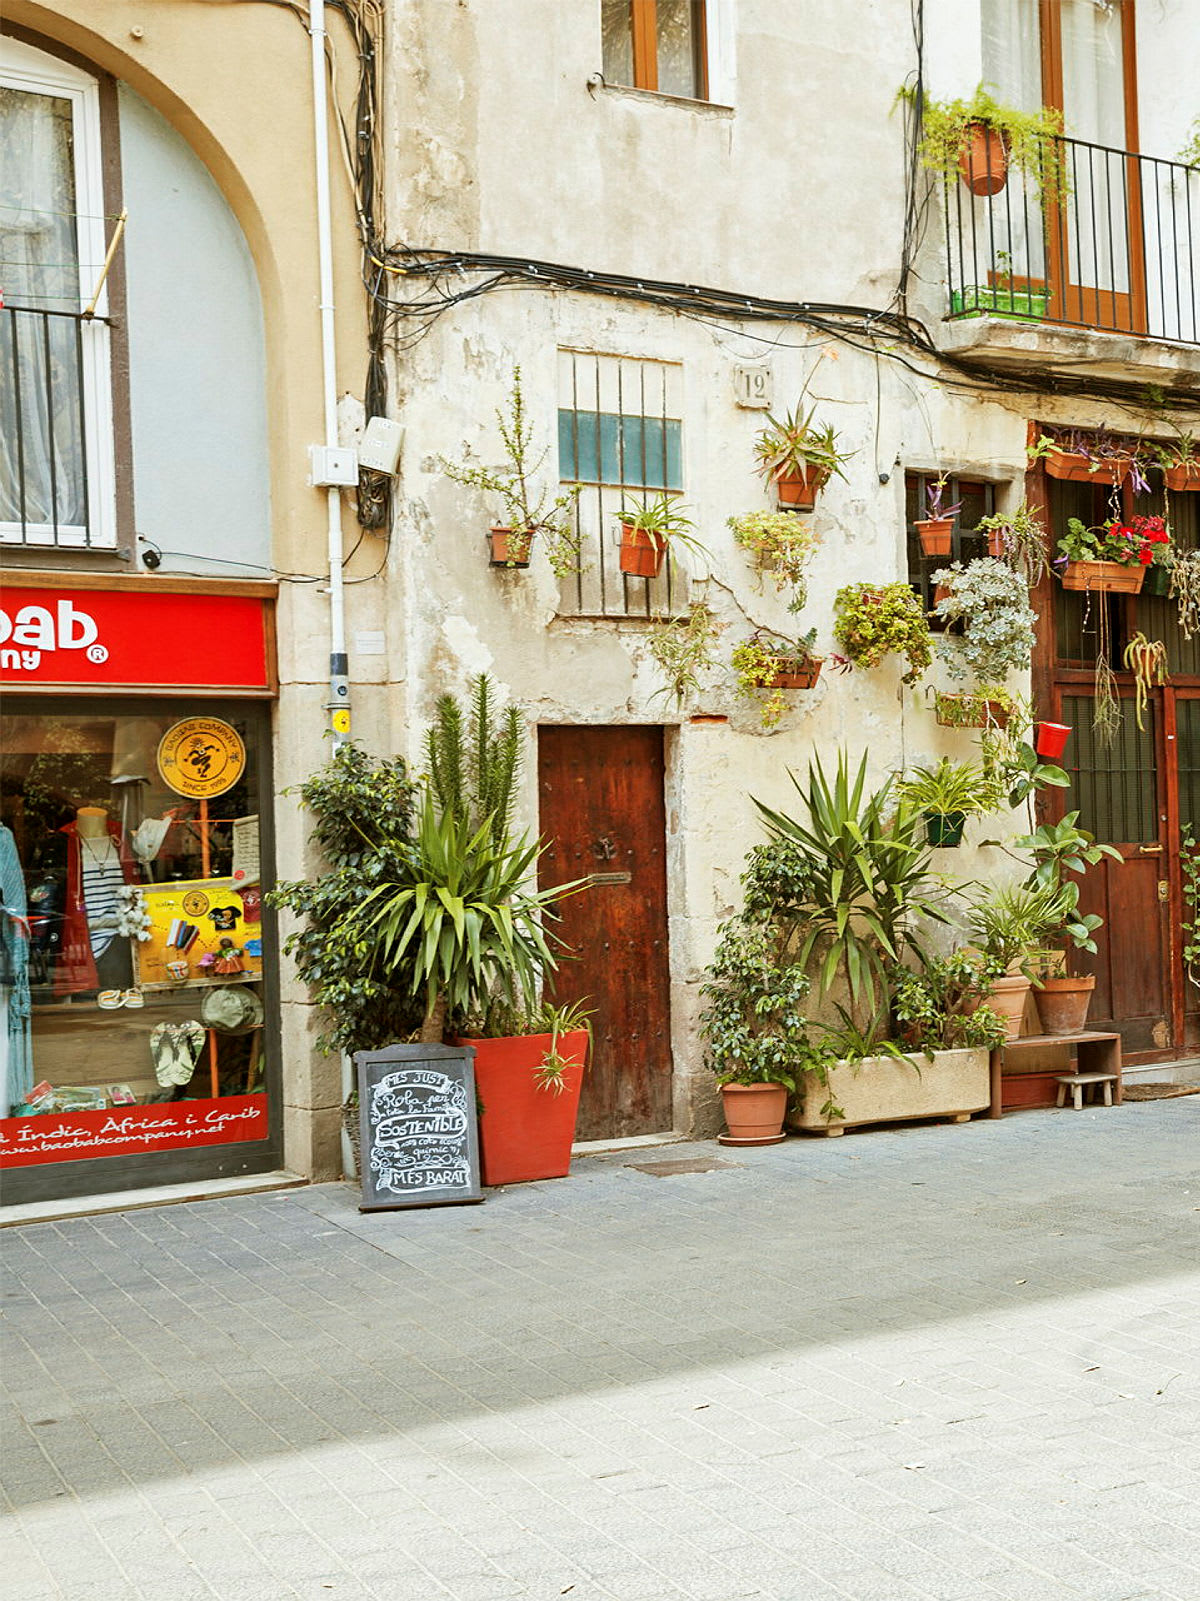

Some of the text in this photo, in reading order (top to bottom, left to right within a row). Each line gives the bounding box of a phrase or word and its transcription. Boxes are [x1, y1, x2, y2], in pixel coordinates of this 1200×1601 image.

[745, 374, 765, 398] 12
[0, 649, 41, 670] ny
[17, 1125, 91, 1142] Índic,
[100, 1116, 179, 1134] Àfrica
[186, 1113, 199, 1124] i
[205, 1106, 261, 1123] Carib
[425, 1170, 464, 1185] BARAT
